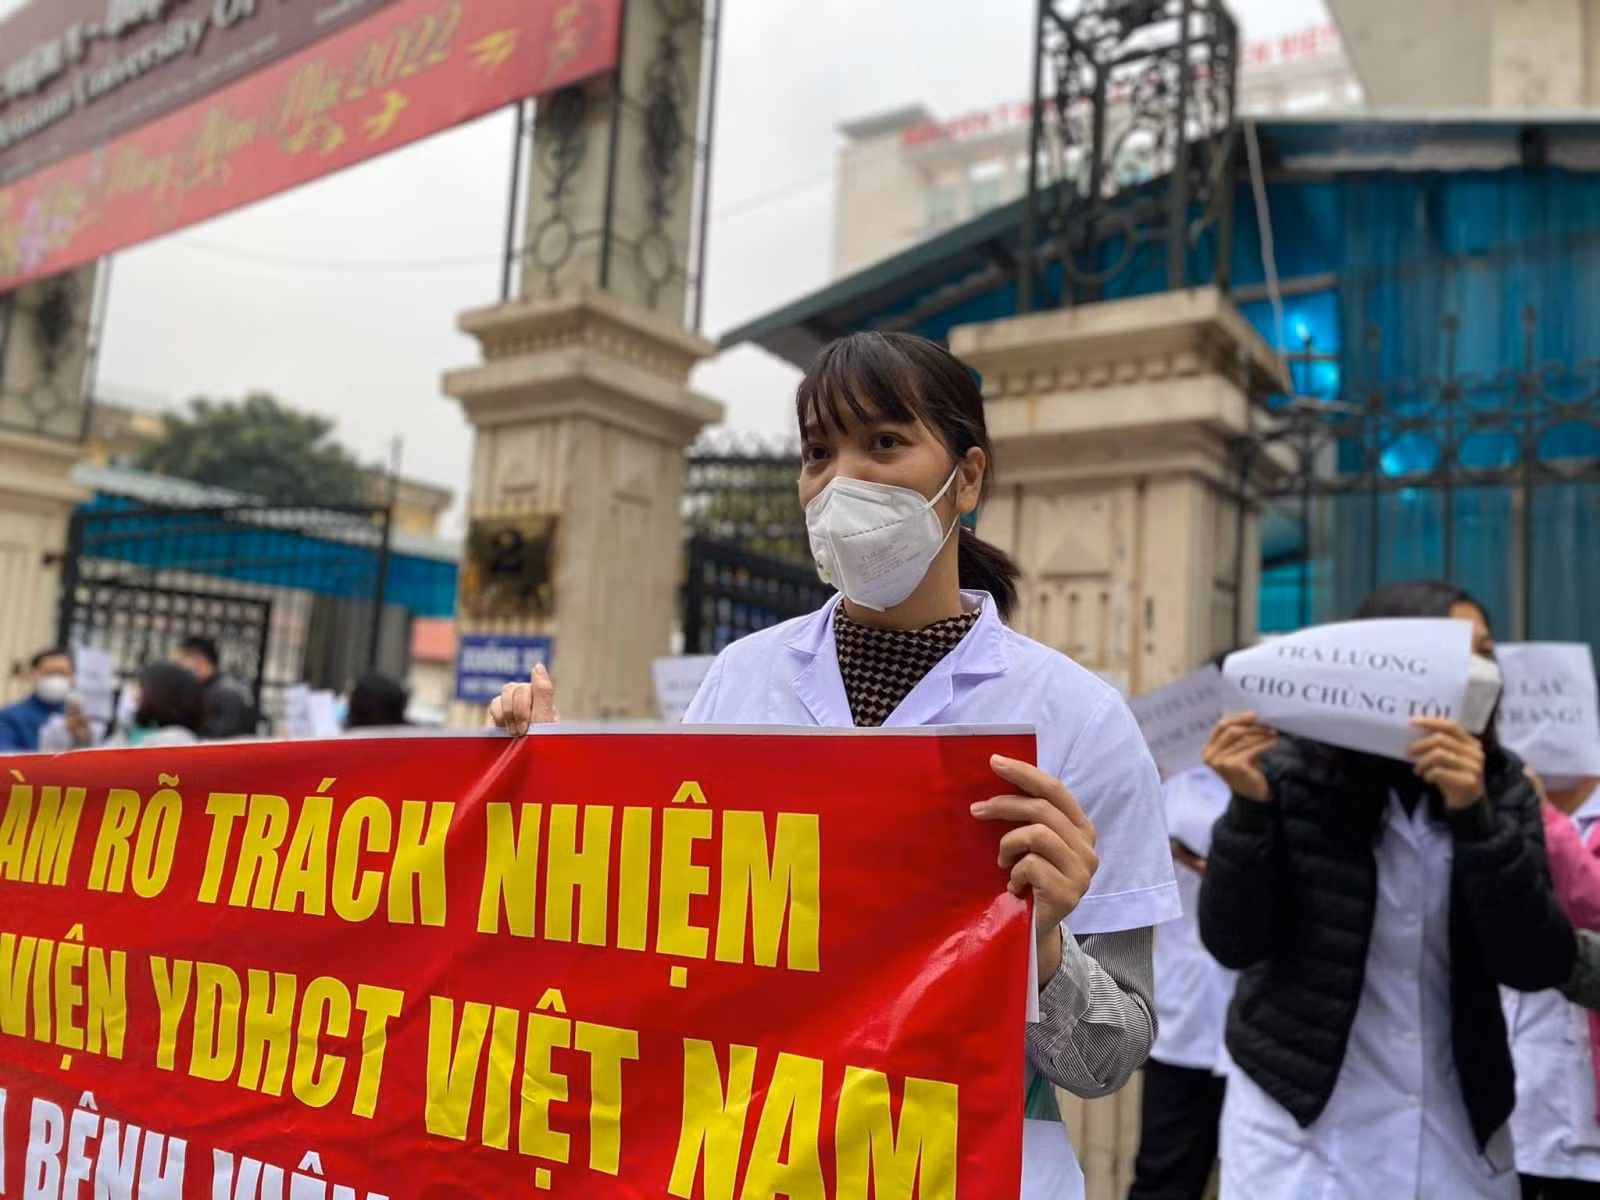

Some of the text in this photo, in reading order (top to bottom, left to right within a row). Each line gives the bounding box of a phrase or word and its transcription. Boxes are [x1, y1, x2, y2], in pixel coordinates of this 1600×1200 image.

[1239, 674, 1295, 698] CHO
[87, 773, 183, 899] RÕ
[196, 777, 456, 928] TRÁCH
[476, 780, 821, 989] NHIỆM
[0, 923, 960, 1200] VIỆN YDHCT VIỆT NAM
